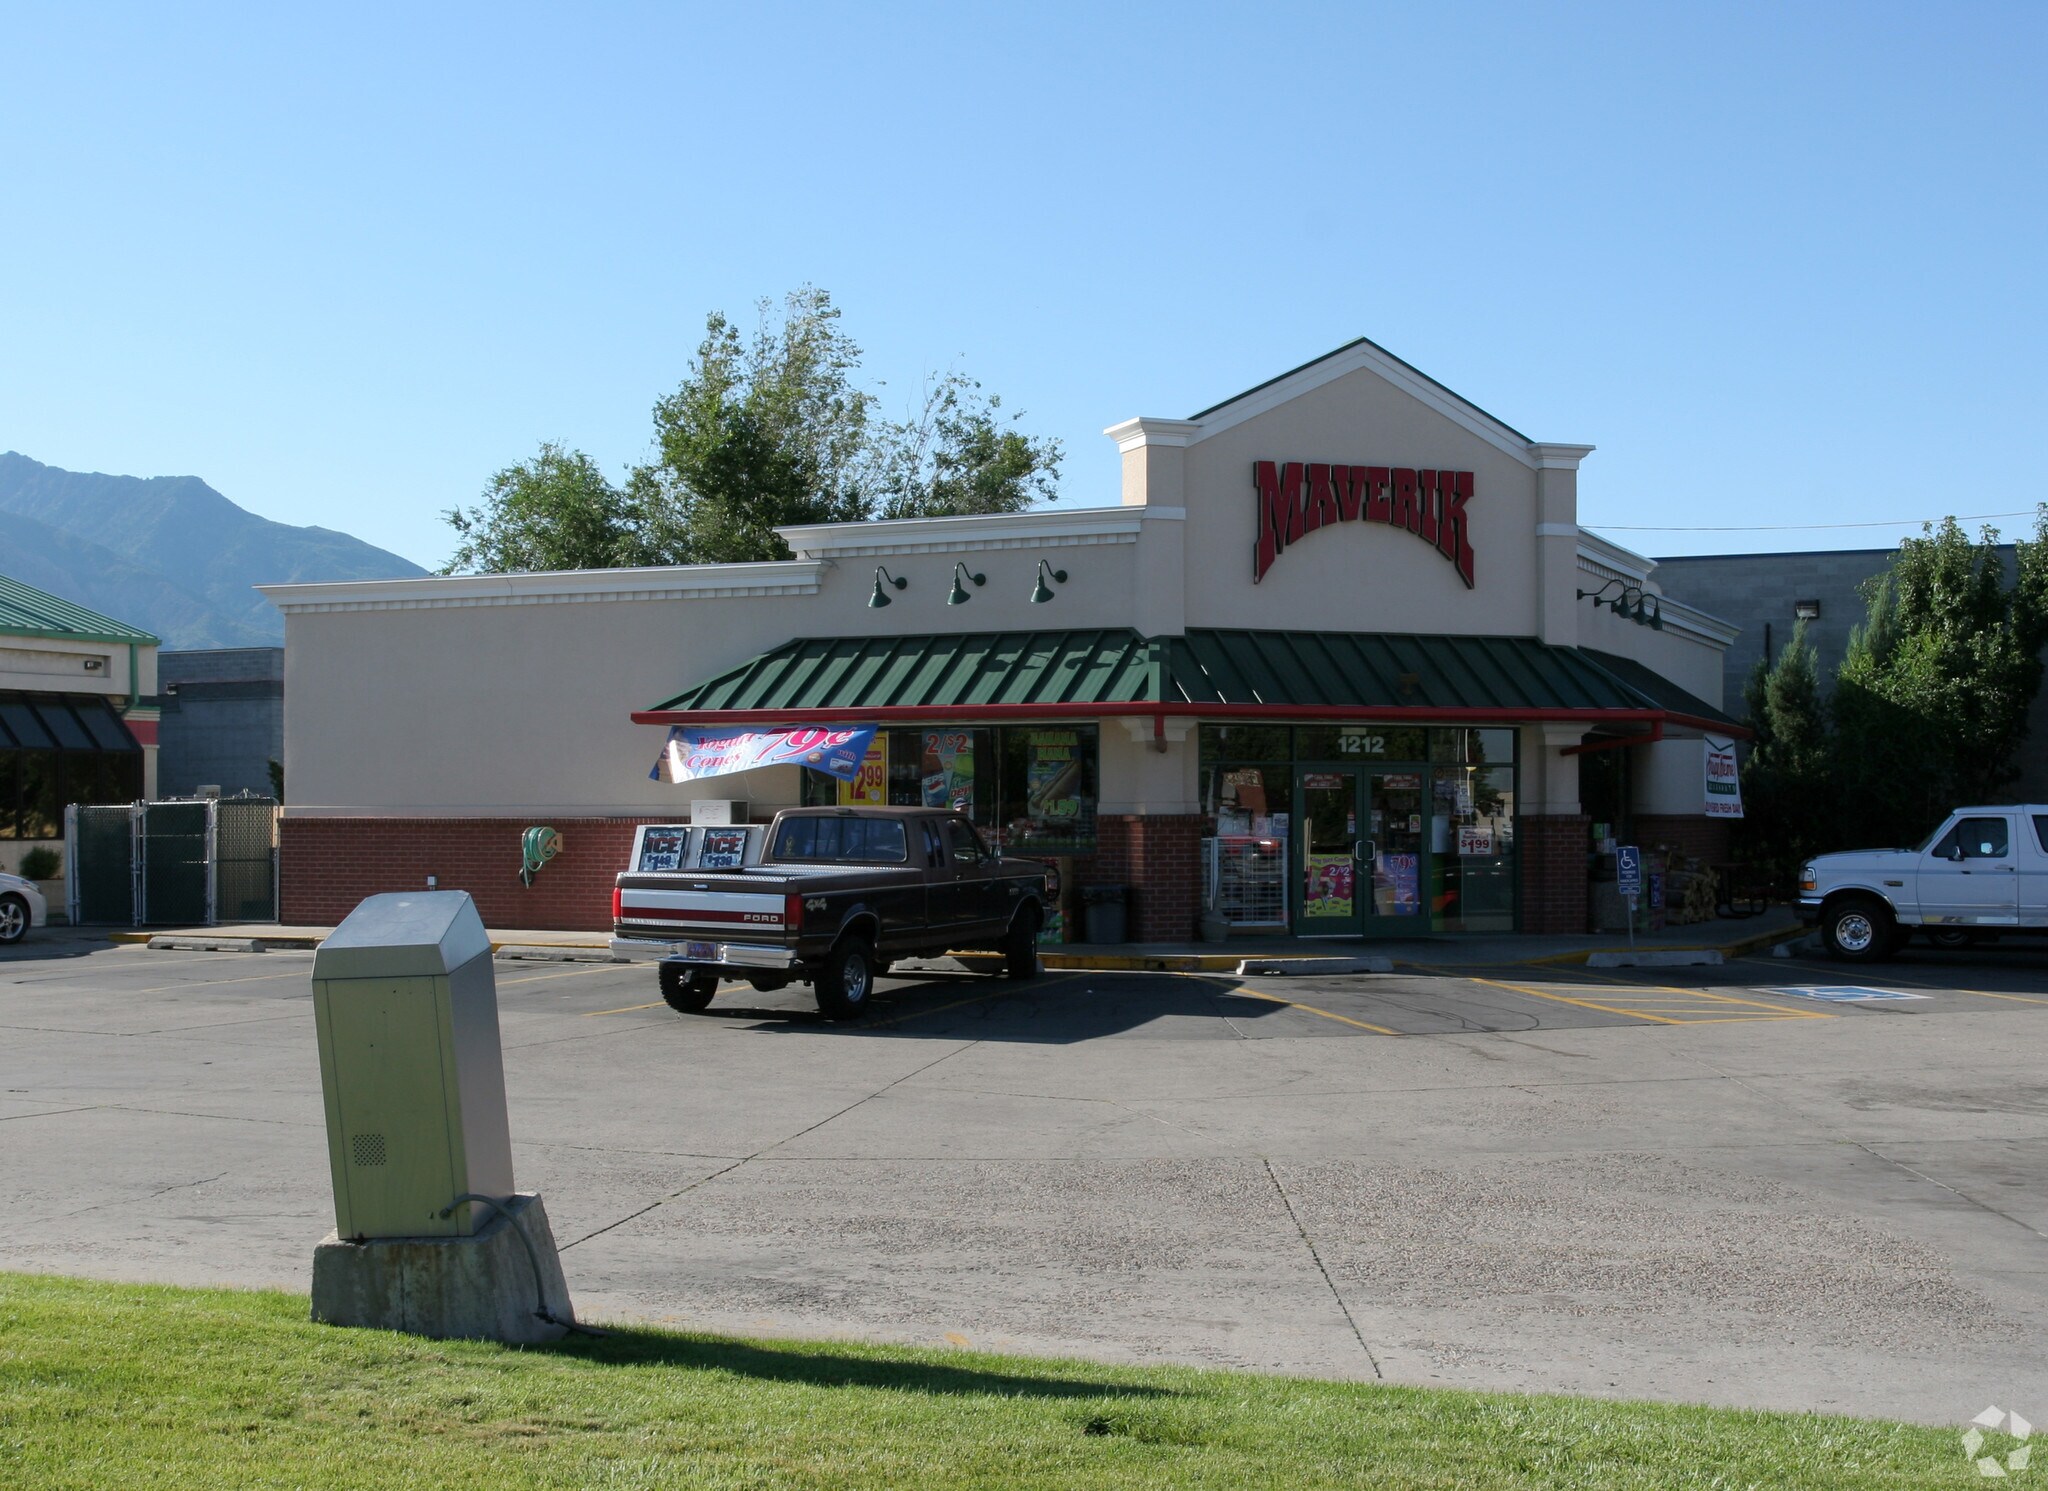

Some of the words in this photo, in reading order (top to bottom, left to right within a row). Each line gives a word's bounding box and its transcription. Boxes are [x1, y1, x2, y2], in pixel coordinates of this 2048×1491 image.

[1253, 460, 1475, 590] MAVERIK
[927, 733, 968, 754] 2/$2
[1338, 736, 1385, 753] 1212
[686, 751, 741, 769] Cones
[646, 836, 682, 854] ICE
[705, 837, 743, 854] ICE
[743, 914, 779, 923] FORD
